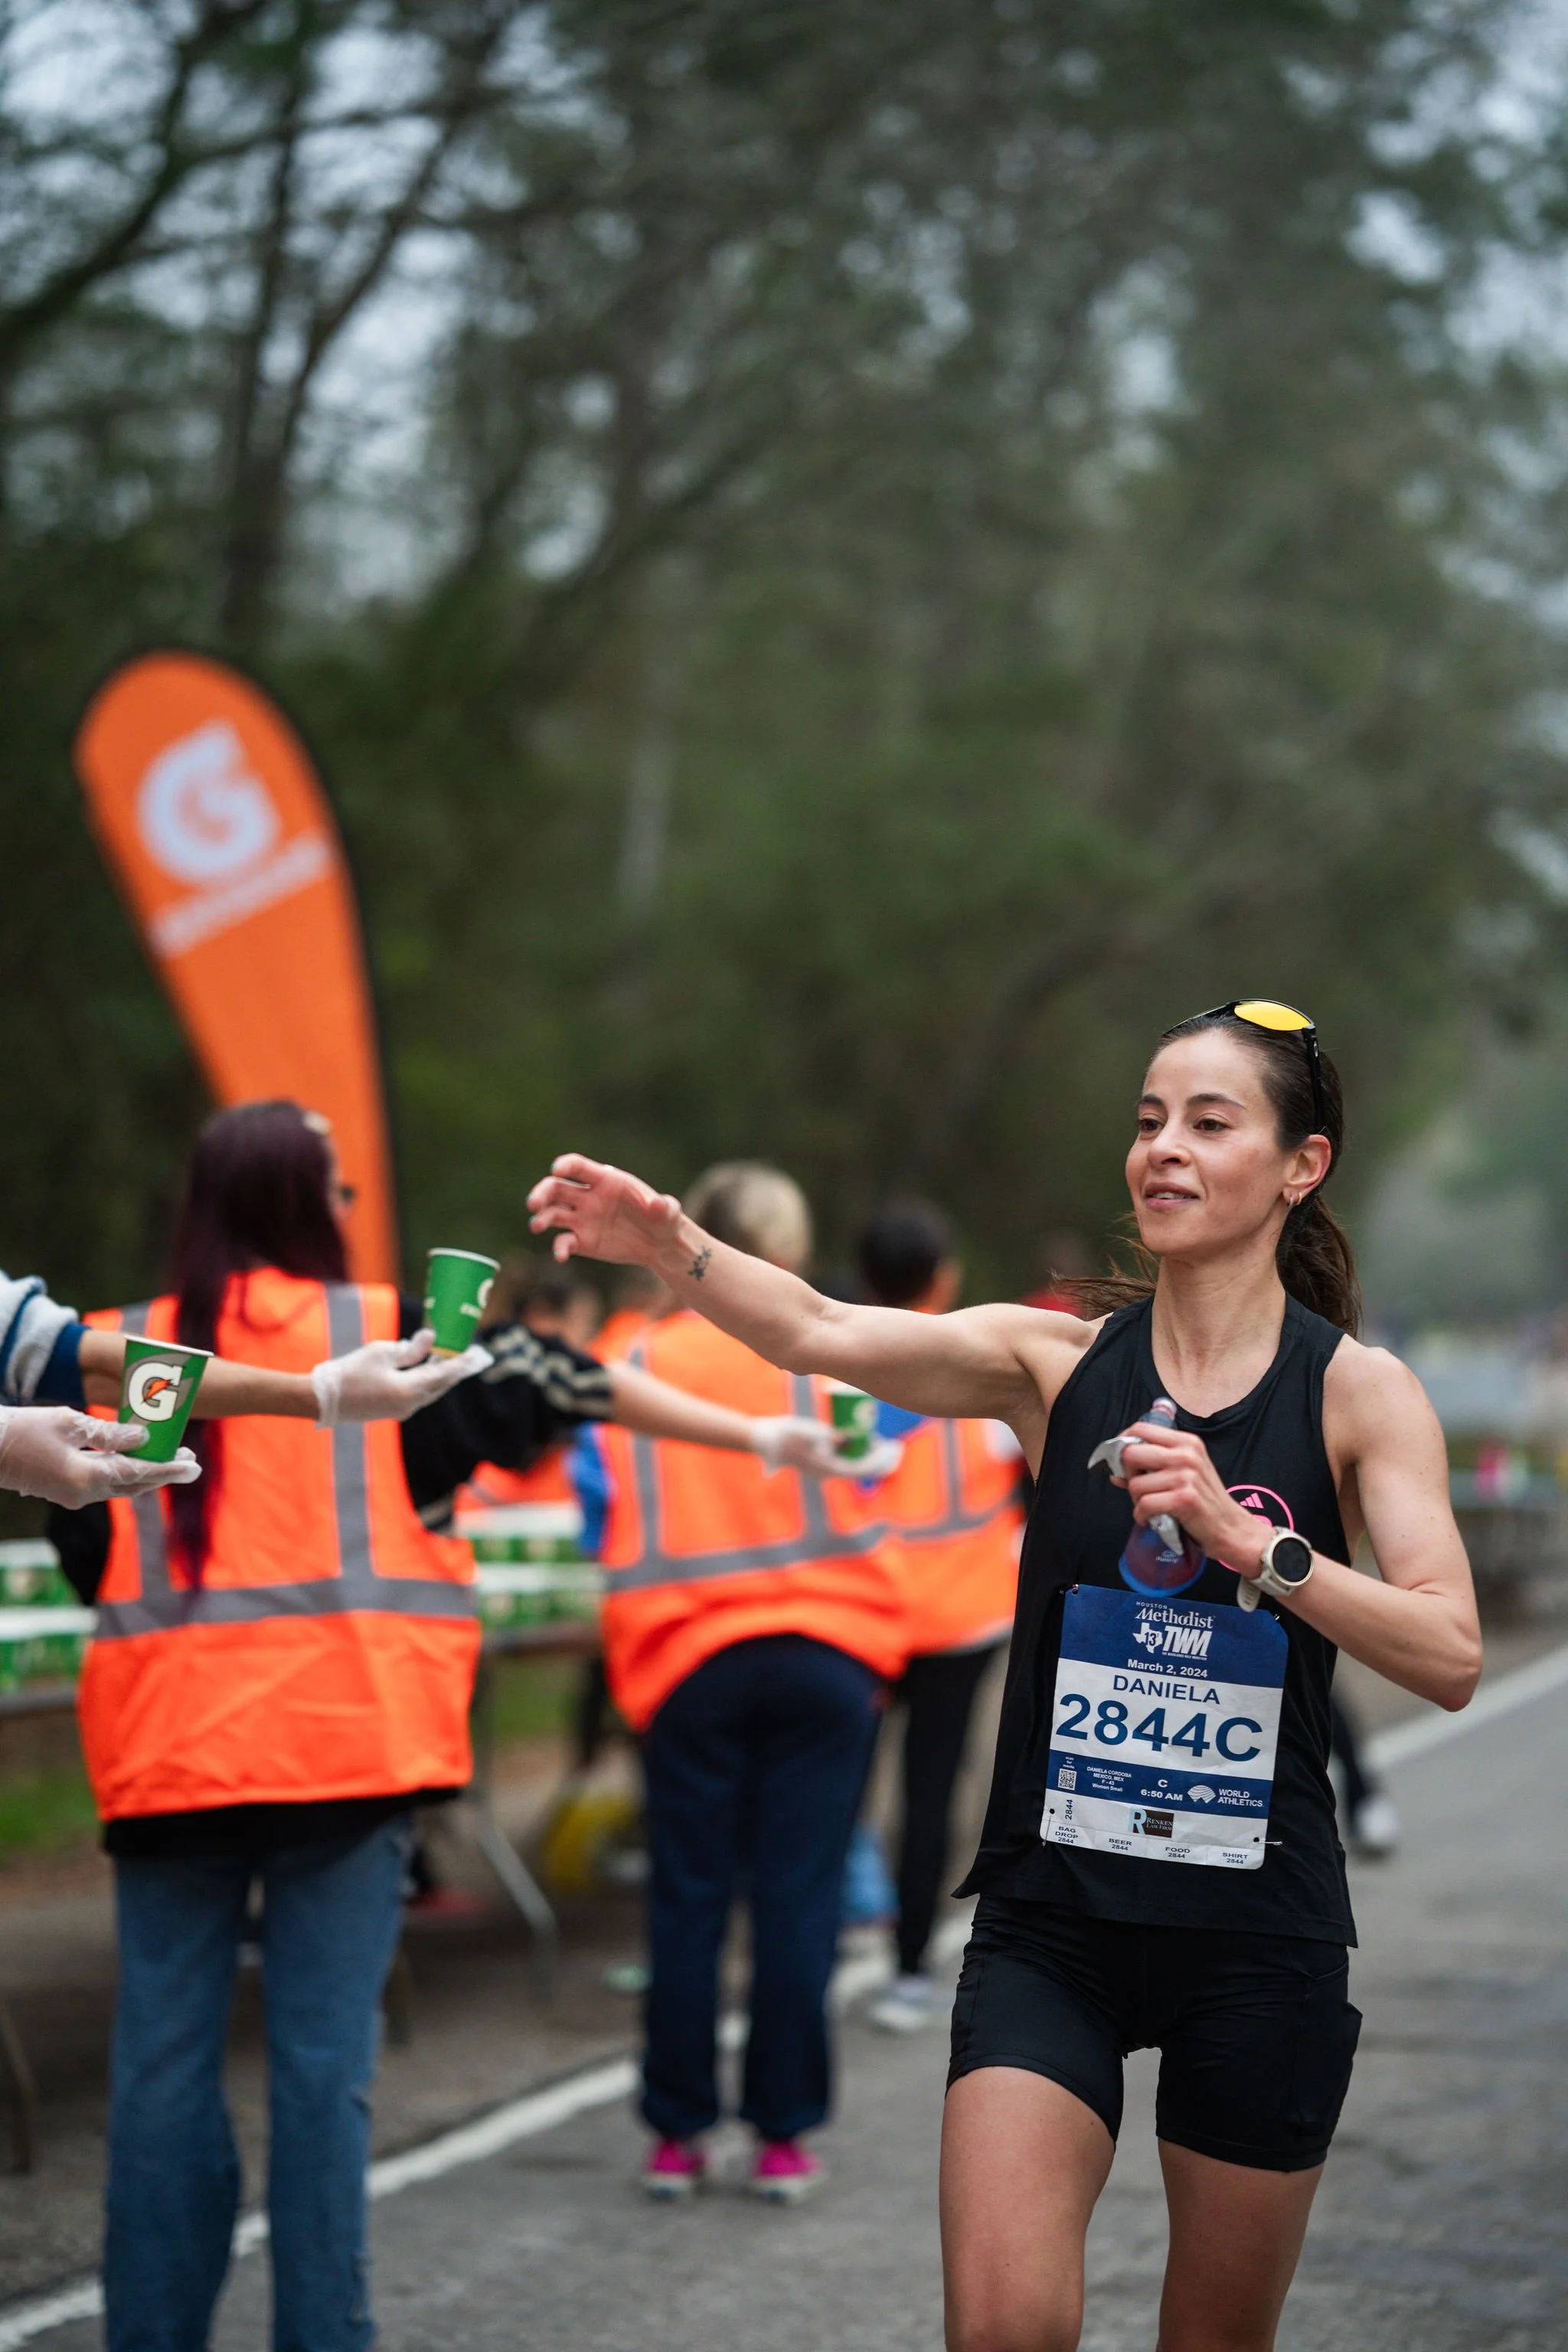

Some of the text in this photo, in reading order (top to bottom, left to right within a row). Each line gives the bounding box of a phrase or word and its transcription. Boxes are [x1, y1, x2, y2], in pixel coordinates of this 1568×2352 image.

[129, 1361, 183, 1422] G
[1135, 1608, 1214, 1629] Methodist
[1162, 1625, 1213, 1657] TWM
[1127, 1658, 1208, 1677] March 2, 2024
[1112, 1674, 1220, 1704] DANIELA
[1056, 1693, 1263, 1762] 2844C
[1158, 1779, 1168, 1788] C
[1219, 1788, 1250, 1798] WORLD
[1140, 1789, 1183, 1801] 6:50 AM
[1217, 1797, 1263, 1807] ATHLETICS
[1065, 1799, 1073, 1820] 2844
